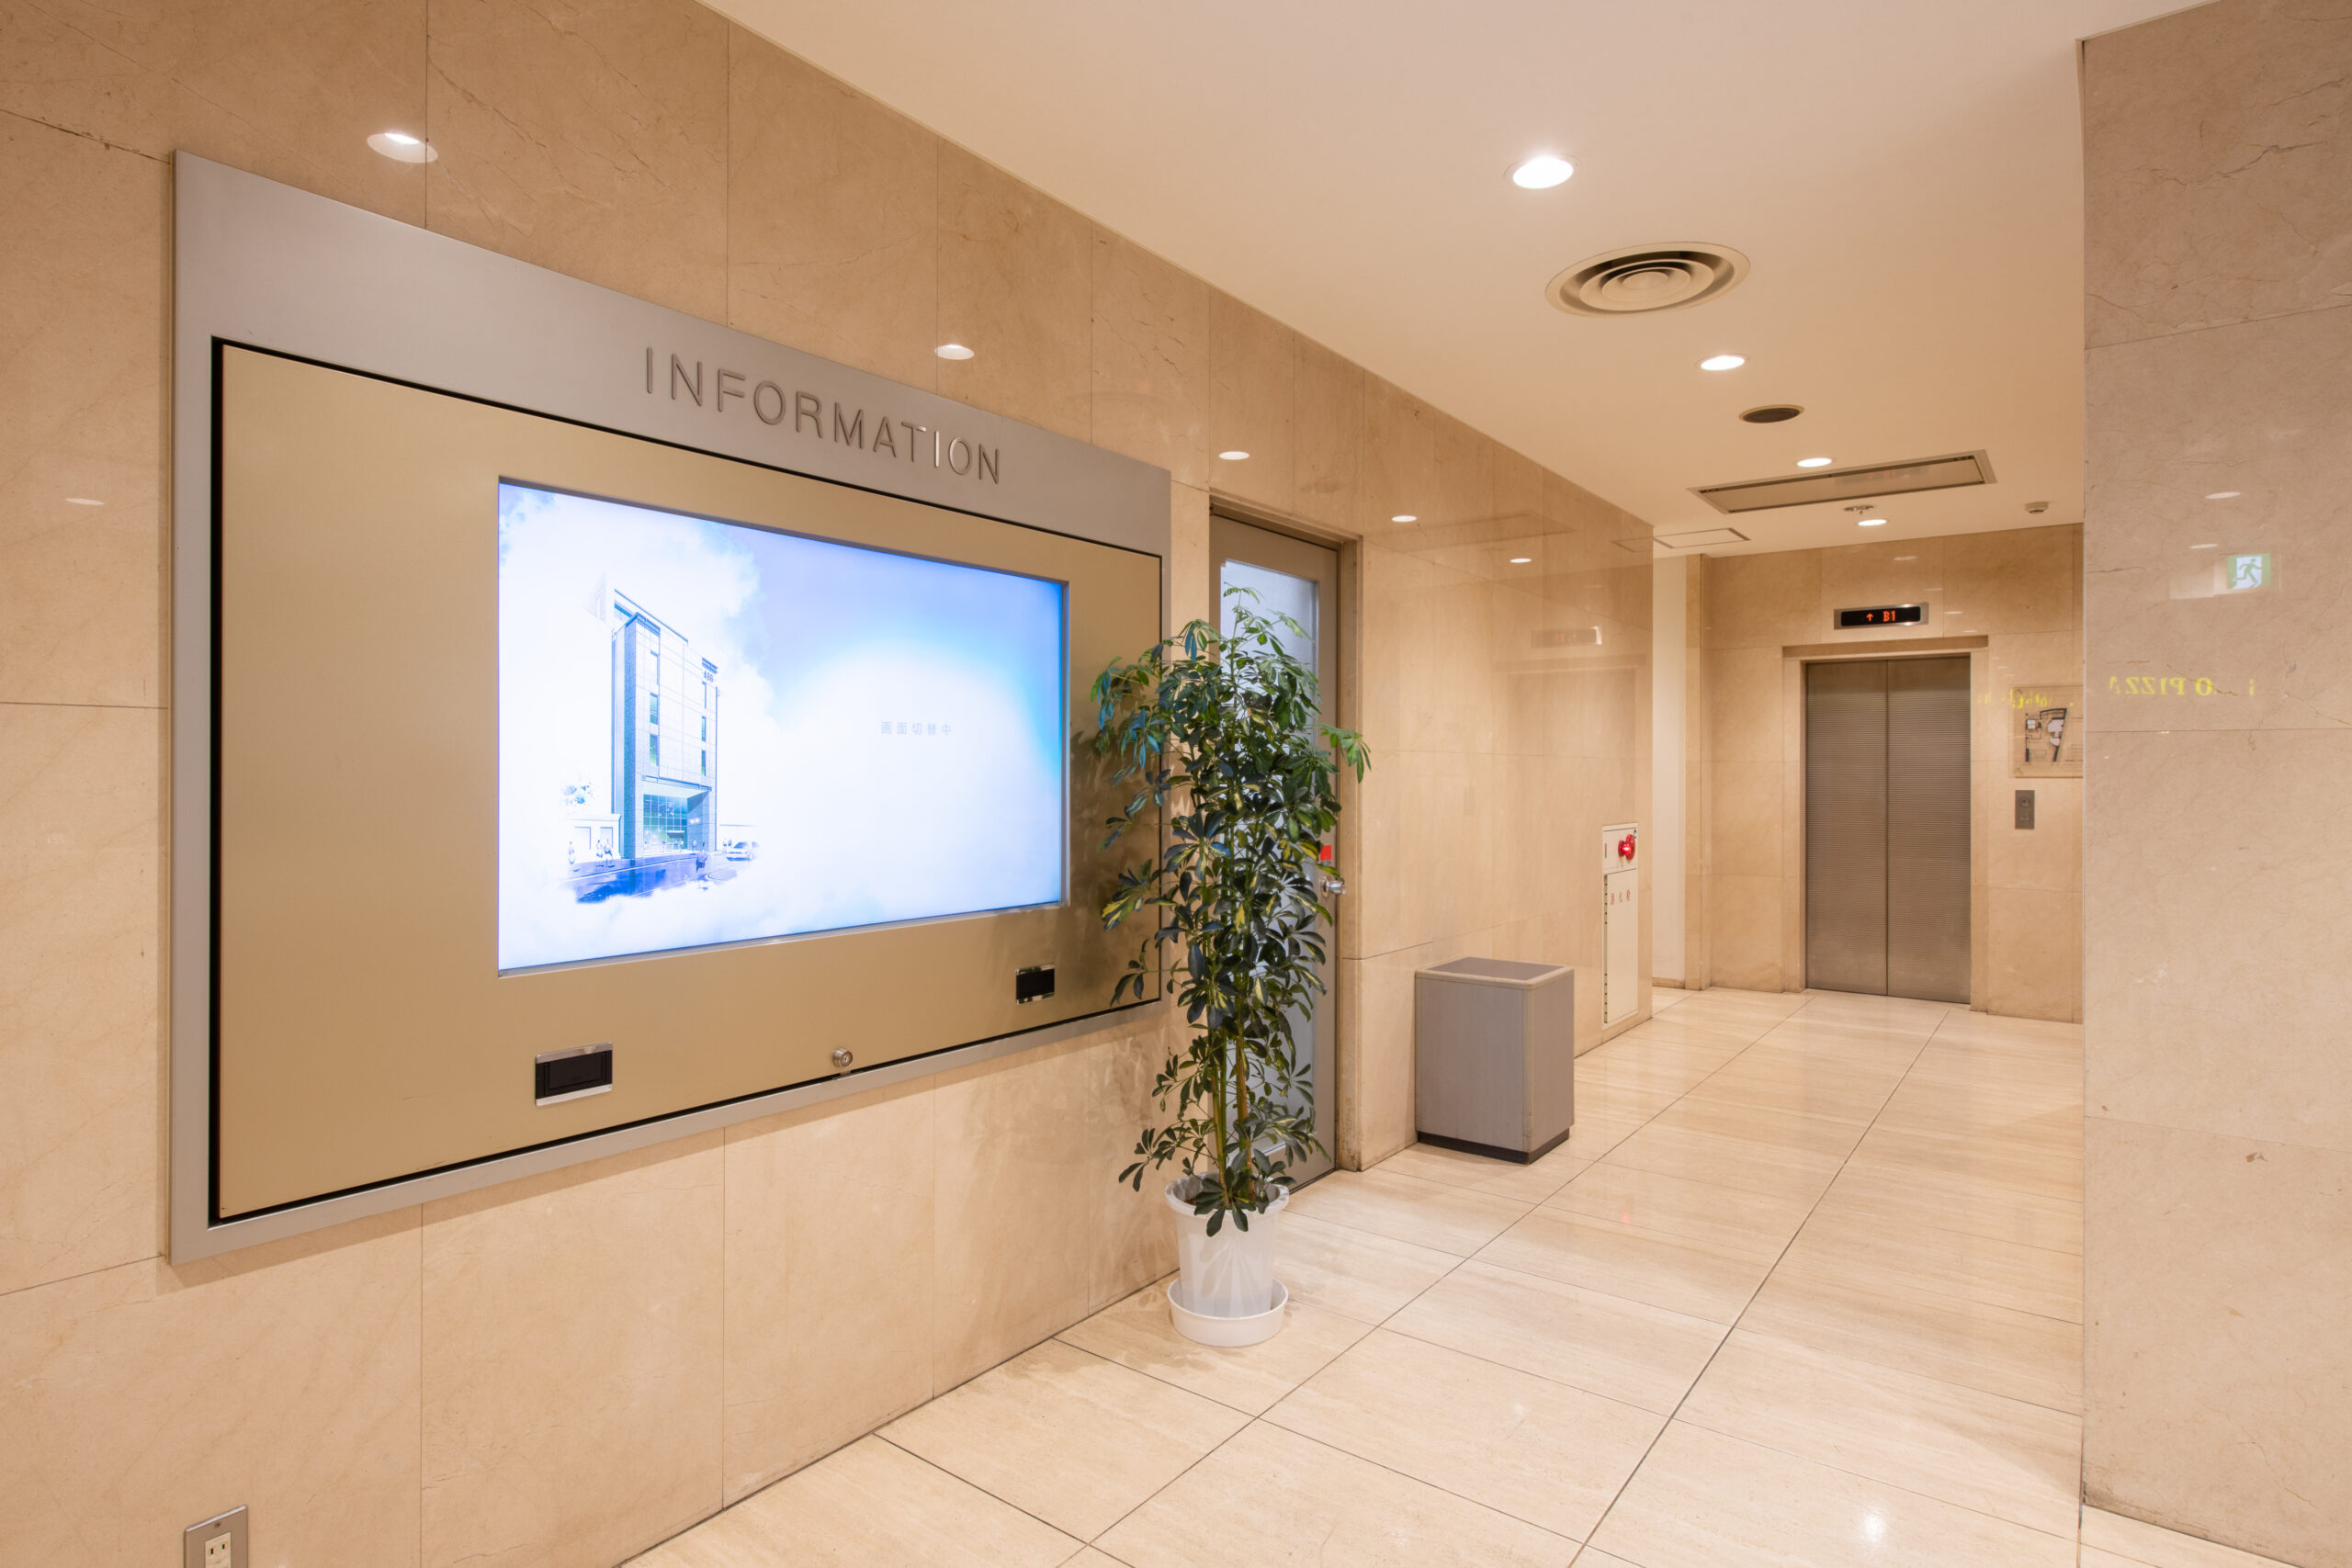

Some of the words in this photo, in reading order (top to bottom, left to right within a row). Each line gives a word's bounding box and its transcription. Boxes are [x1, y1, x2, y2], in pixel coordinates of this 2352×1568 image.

[646, 345, 1001, 485] INFORMATION
[1883, 610, 1896, 622] B1
[880, 721, 952, 736] 画面切替中
